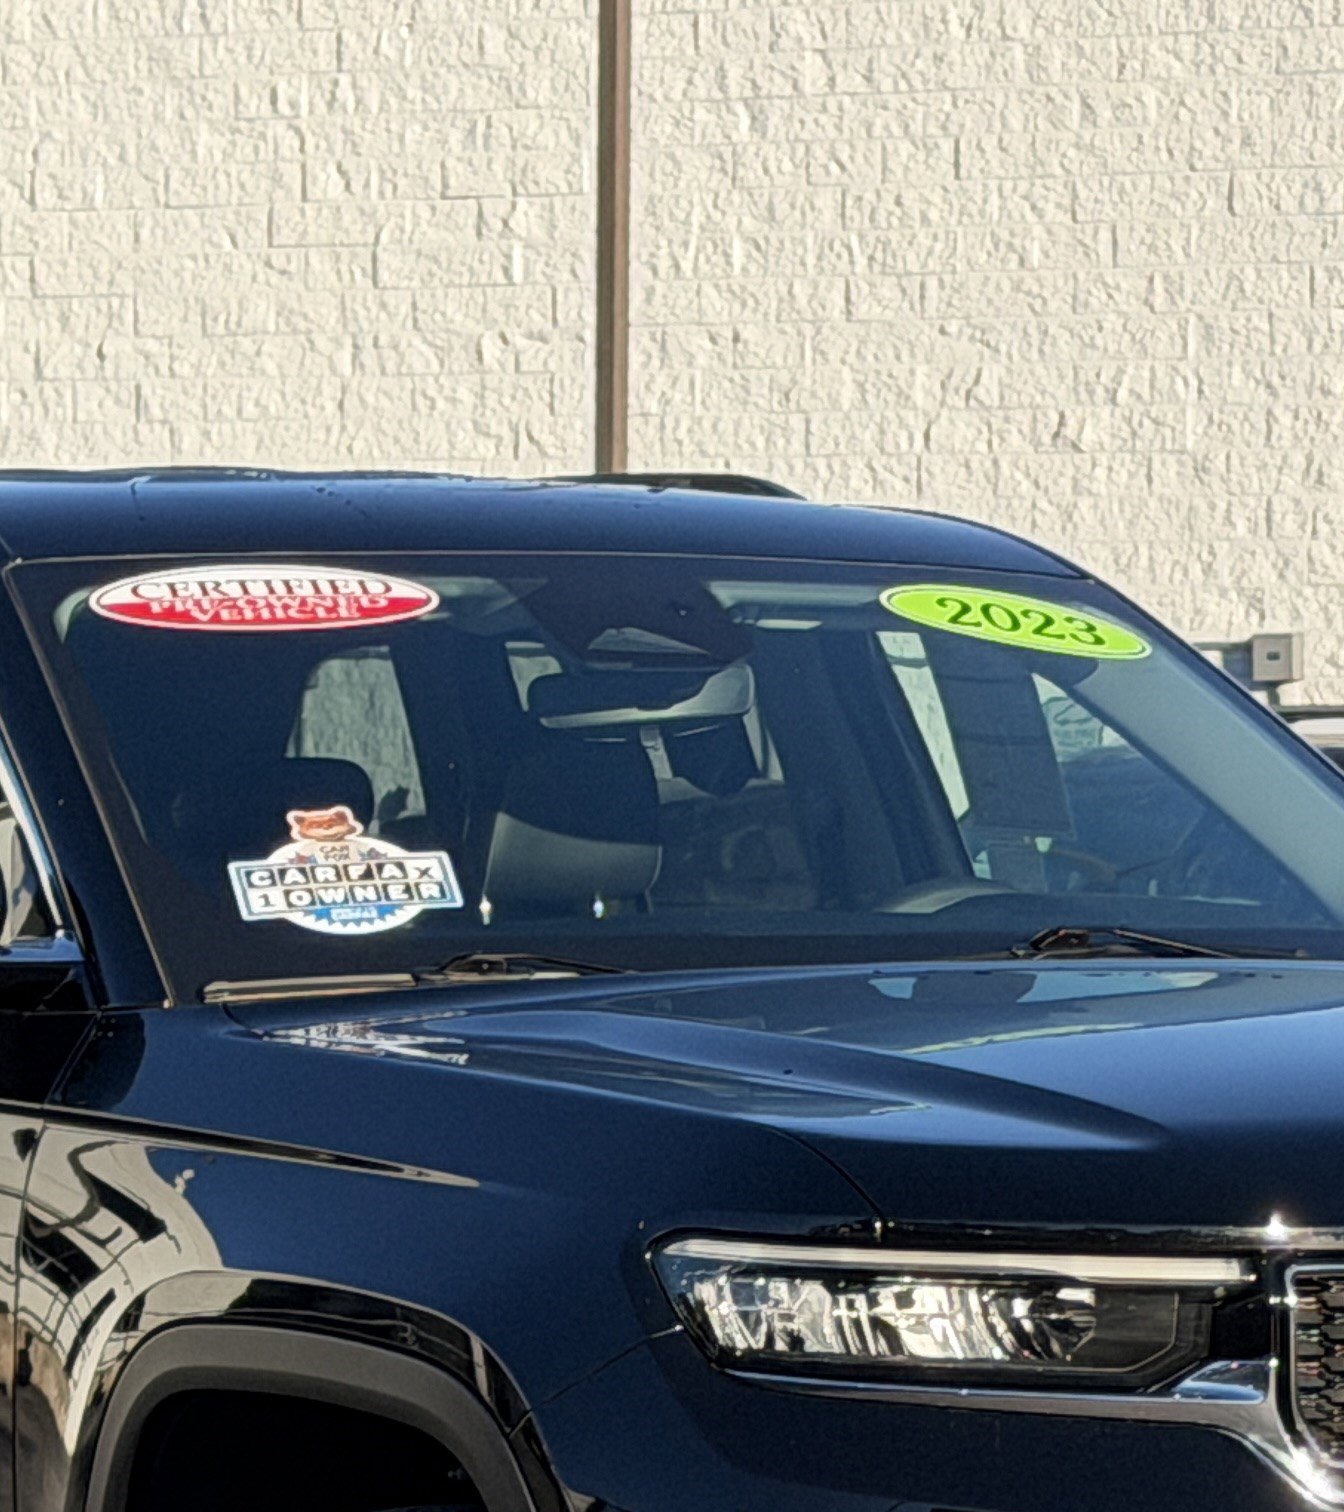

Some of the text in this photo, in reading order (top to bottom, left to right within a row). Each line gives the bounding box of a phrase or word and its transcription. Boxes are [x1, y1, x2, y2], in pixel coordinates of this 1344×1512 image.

[130, 578, 393, 601] CERTIFIED
[190, 605, 363, 623] VEHICLE
[935, 596, 1107, 646] 2023
[250, 863, 433, 887] CARFAX
[258, 883, 442, 908] 1 OWNER
